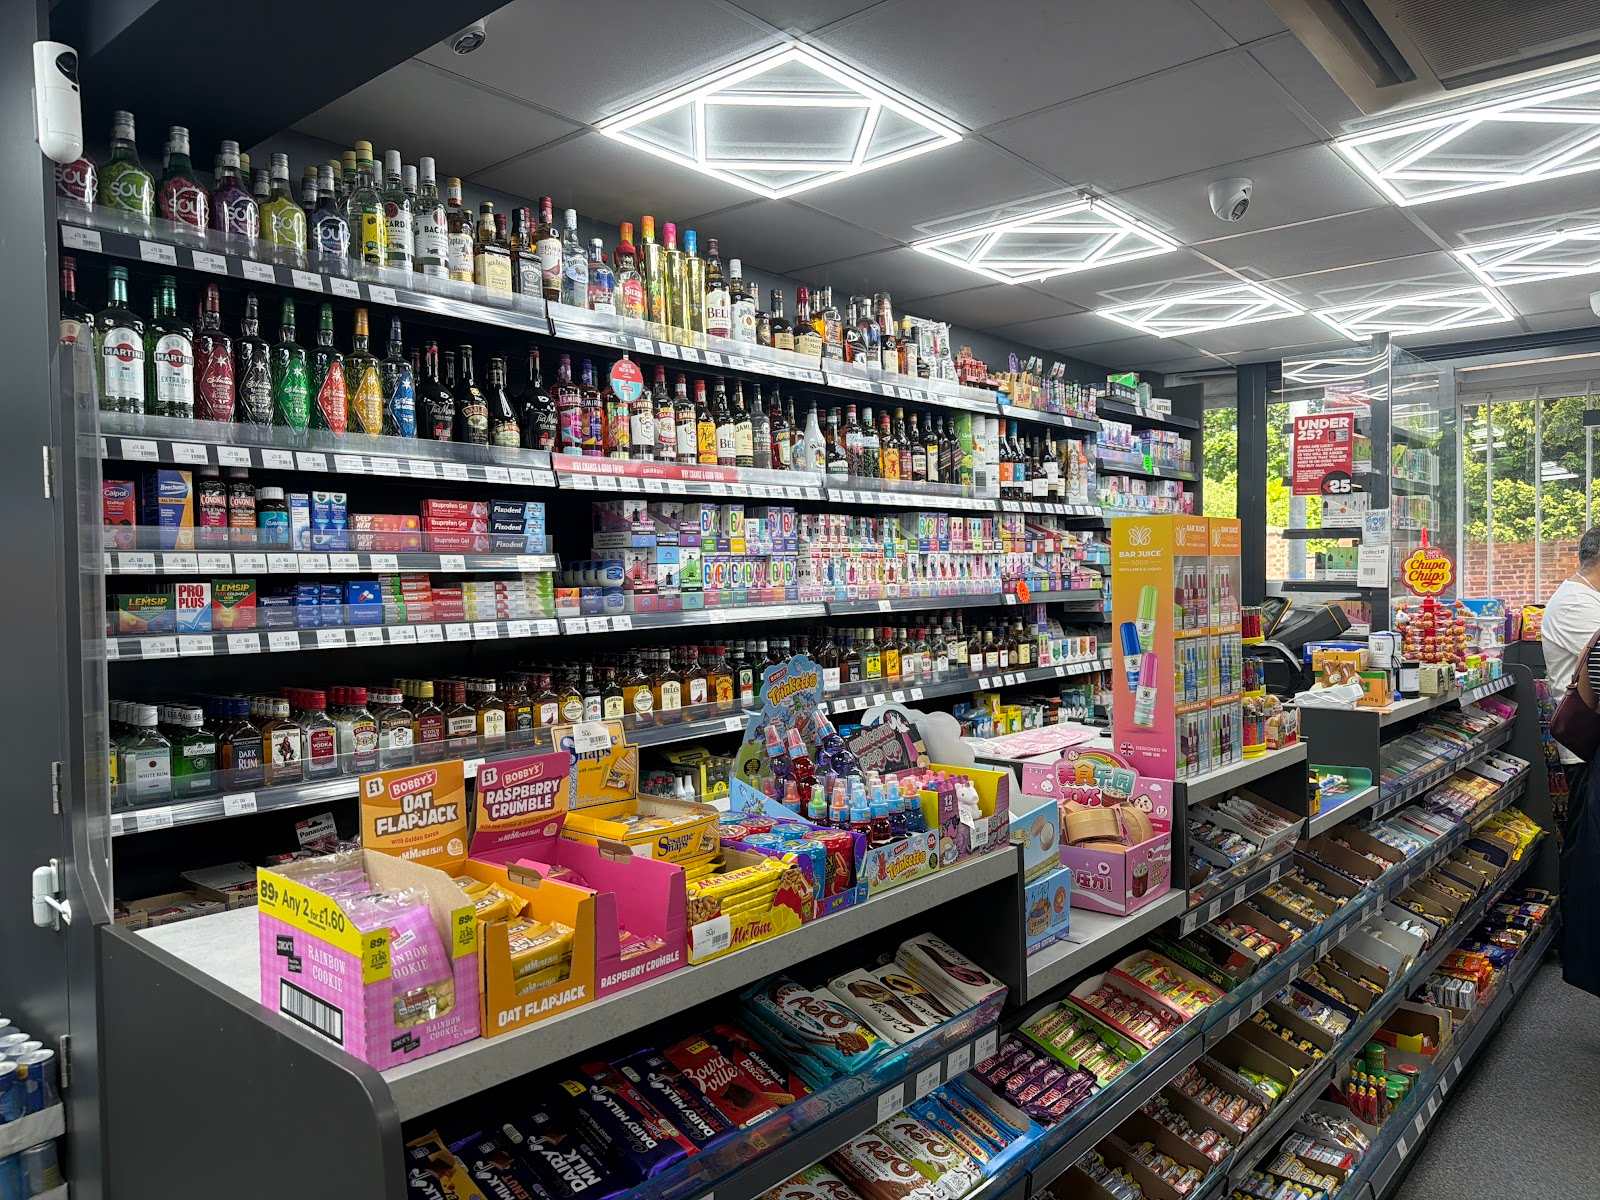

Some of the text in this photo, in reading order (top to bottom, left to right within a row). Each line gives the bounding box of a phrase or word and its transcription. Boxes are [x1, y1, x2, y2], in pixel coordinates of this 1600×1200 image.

[104, 347, 145, 360] MARTINI
[156, 353, 193, 365] MARTINI
[1297, 417, 1350, 430] UNDER
[1297, 429, 1323, 441] 25?
[103, 489, 128, 498] Calpol
[1329, 479, 1351, 494] 25
[432, 502, 457, 510] Ibuprofen
[494, 505, 522, 514] Fixodent
[432, 519, 457, 527] Ibuprofen
[494, 523, 522, 531] Fixodent
[434, 537, 459, 545] Ibuprofen
[496, 540, 523, 548] Fixodent
[1410, 560, 1446, 571] Chupa
[1409, 570, 1444, 582] Chups
[178, 585, 204, 597] PRO
[215, 583, 250, 591] LEMSIP
[128, 597, 168, 606] LEMSIP
[178, 597, 205, 608] PLUS
[486, 714, 503, 722] BELL'S
[239, 749, 256, 758] DARK
[238, 758, 258, 770] RUM
[484, 770, 495, 784] £1
[503, 764, 542, 784] BOBBY'S
[368, 780, 380, 794] £1
[391, 772, 436, 795] BOBBY'S
[486, 777, 560, 805] RASPBERRY
[1062, 787, 1100, 806] TOYS
[403, 791, 433, 811] OAT
[491, 795, 552, 818] CRUMBLE
[377, 805, 458, 835] FLAPJACK
[298, 823, 334, 839] Panasonic
[260, 880, 345, 933] 89p Any 2 for £1.60
[459, 913, 472, 925] 89p
[370, 937, 386, 949] 89p
[307, 945, 345, 975] RAINBOW
[600, 950, 680, 989] RASPBERRY CRUMBLE
[313, 965, 343, 992] COOKIE
[498, 985, 586, 1027] OAT FLAPJACK
[796, 996, 849, 1030] Aero
[741, 1058, 775, 1088] Biscoff
[766, 1067, 786, 1085] MILK
[661, 1084, 716, 1138] DAIRY MILK
[604, 1098, 658, 1150] DAIRY MILK
[893, 1123, 951, 1158] Aero
[855, 1140, 918, 1178] Aero
[541, 1150, 589, 1193] DAIRY
[565, 1148, 602, 1187] MILK
